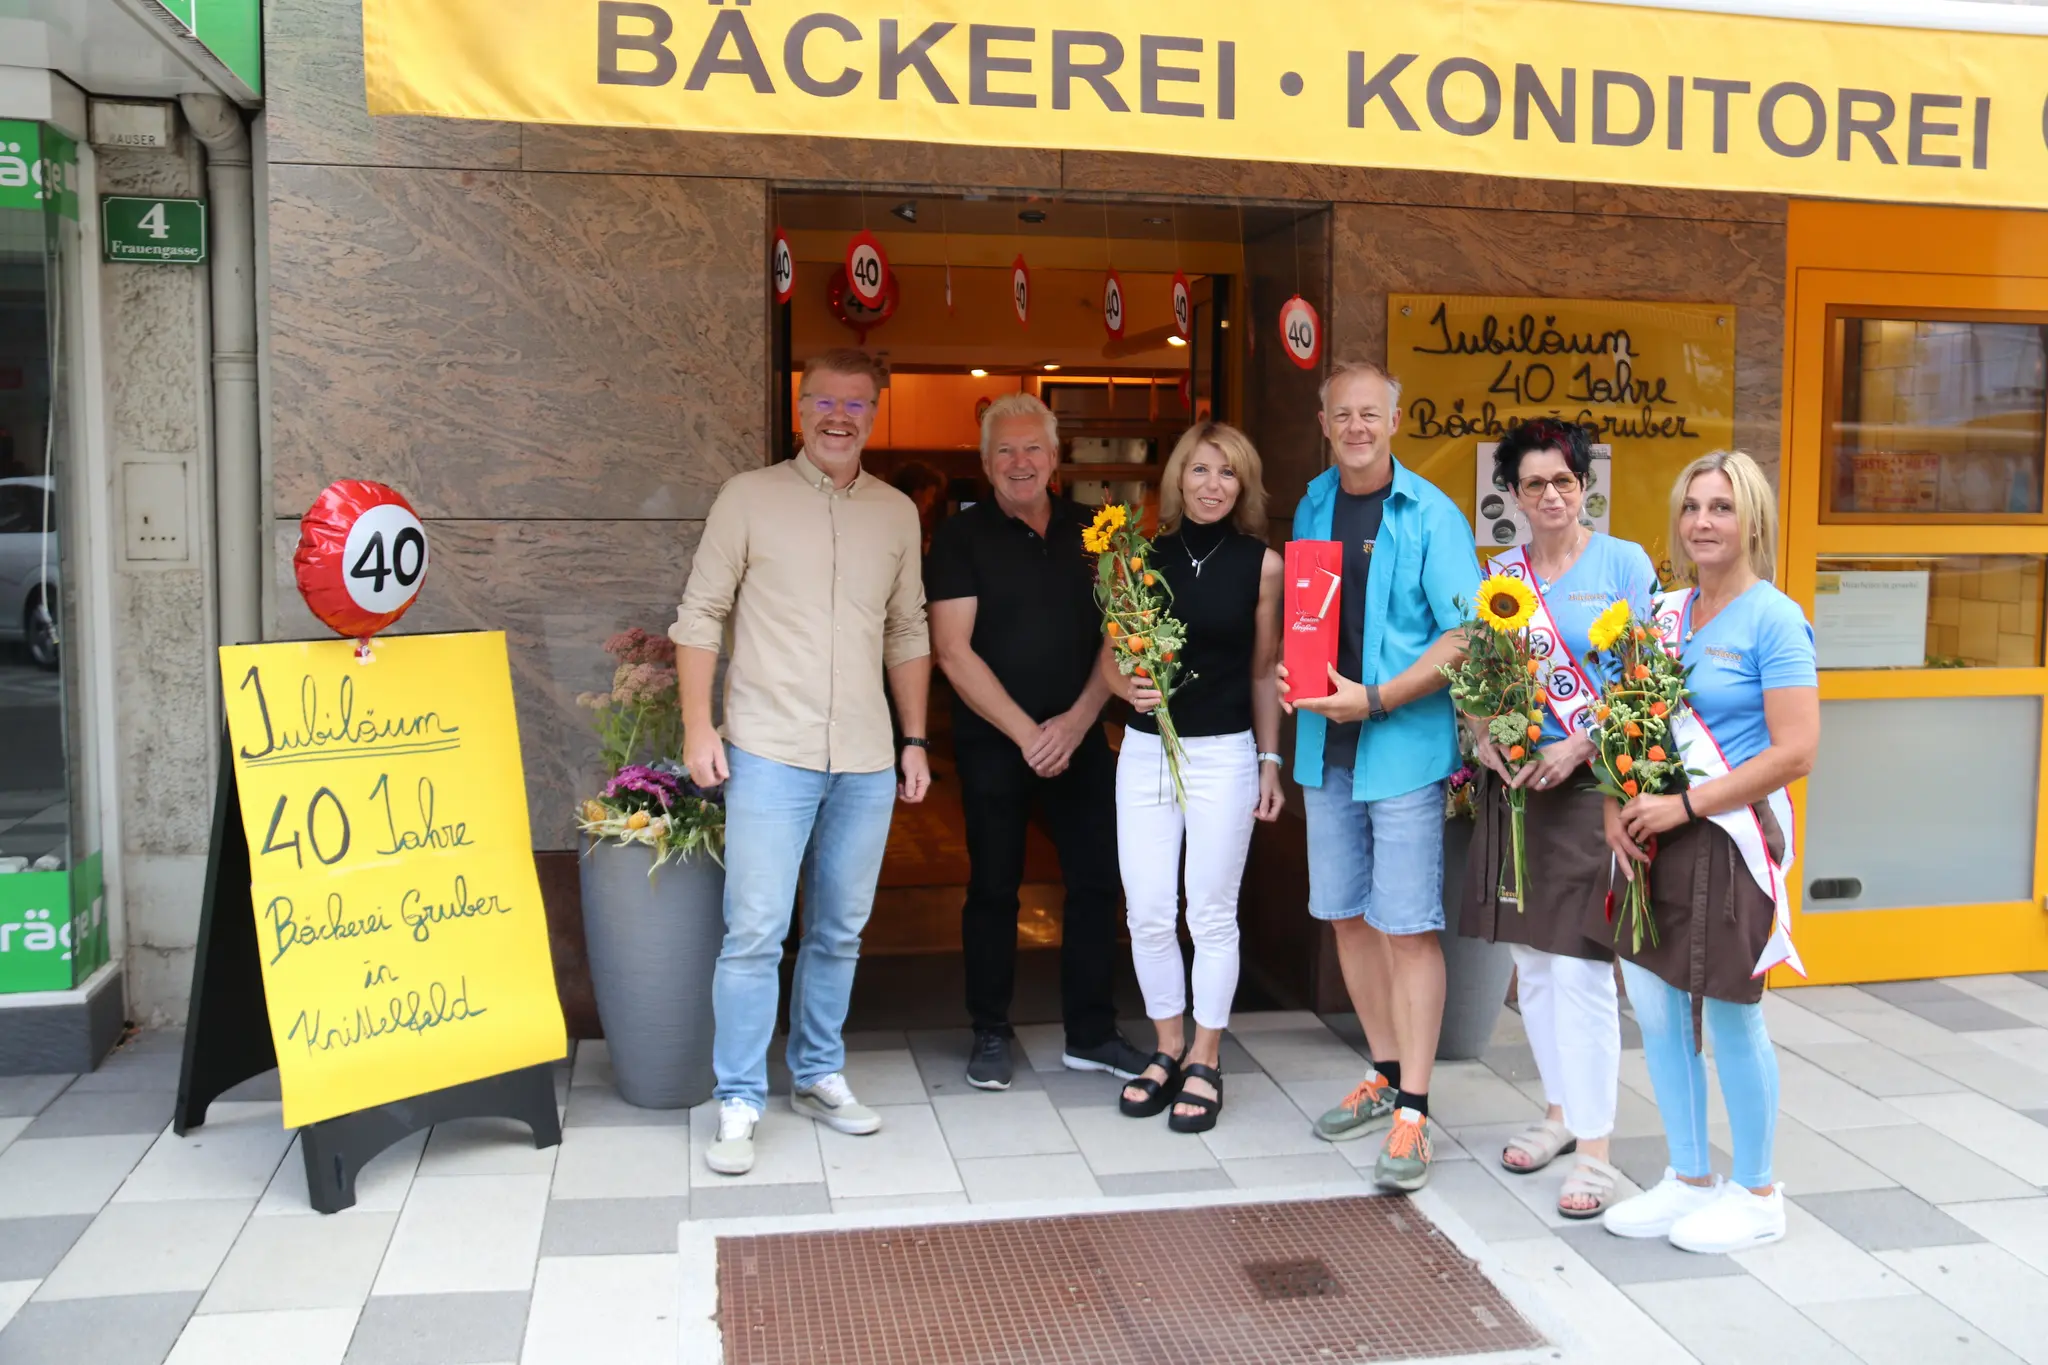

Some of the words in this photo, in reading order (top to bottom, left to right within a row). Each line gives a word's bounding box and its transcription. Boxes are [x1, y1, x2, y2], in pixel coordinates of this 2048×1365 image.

[597, 0, 1235, 120] BÄCKEREI
[1347, 50, 1992, 170] KONDITOREI
[137, 202, 170, 239] 4
[111, 240, 199, 259] Frauengasse
[775, 250, 790, 282] 40
[854, 256, 879, 287] 40
[1106, 289, 1120, 320] 40
[1175, 295, 1187, 323] 40
[1288, 320, 1312, 349] 40
[1413, 302, 1639, 357] Jubiläum
[1488, 360, 1554, 404] 40
[1566, 359, 1677, 405] Jahre
[350, 526, 425, 593] 40
[1553, 673, 1573, 696] 40
[240, 665, 459, 759] Jubiläum
[260, 786, 352, 869] 40
[369, 773, 475, 855] Jahre
[264, 892, 393, 966] Bäckerei
[400, 875, 512, 942] Gruber
[362, 961, 400, 989] in
